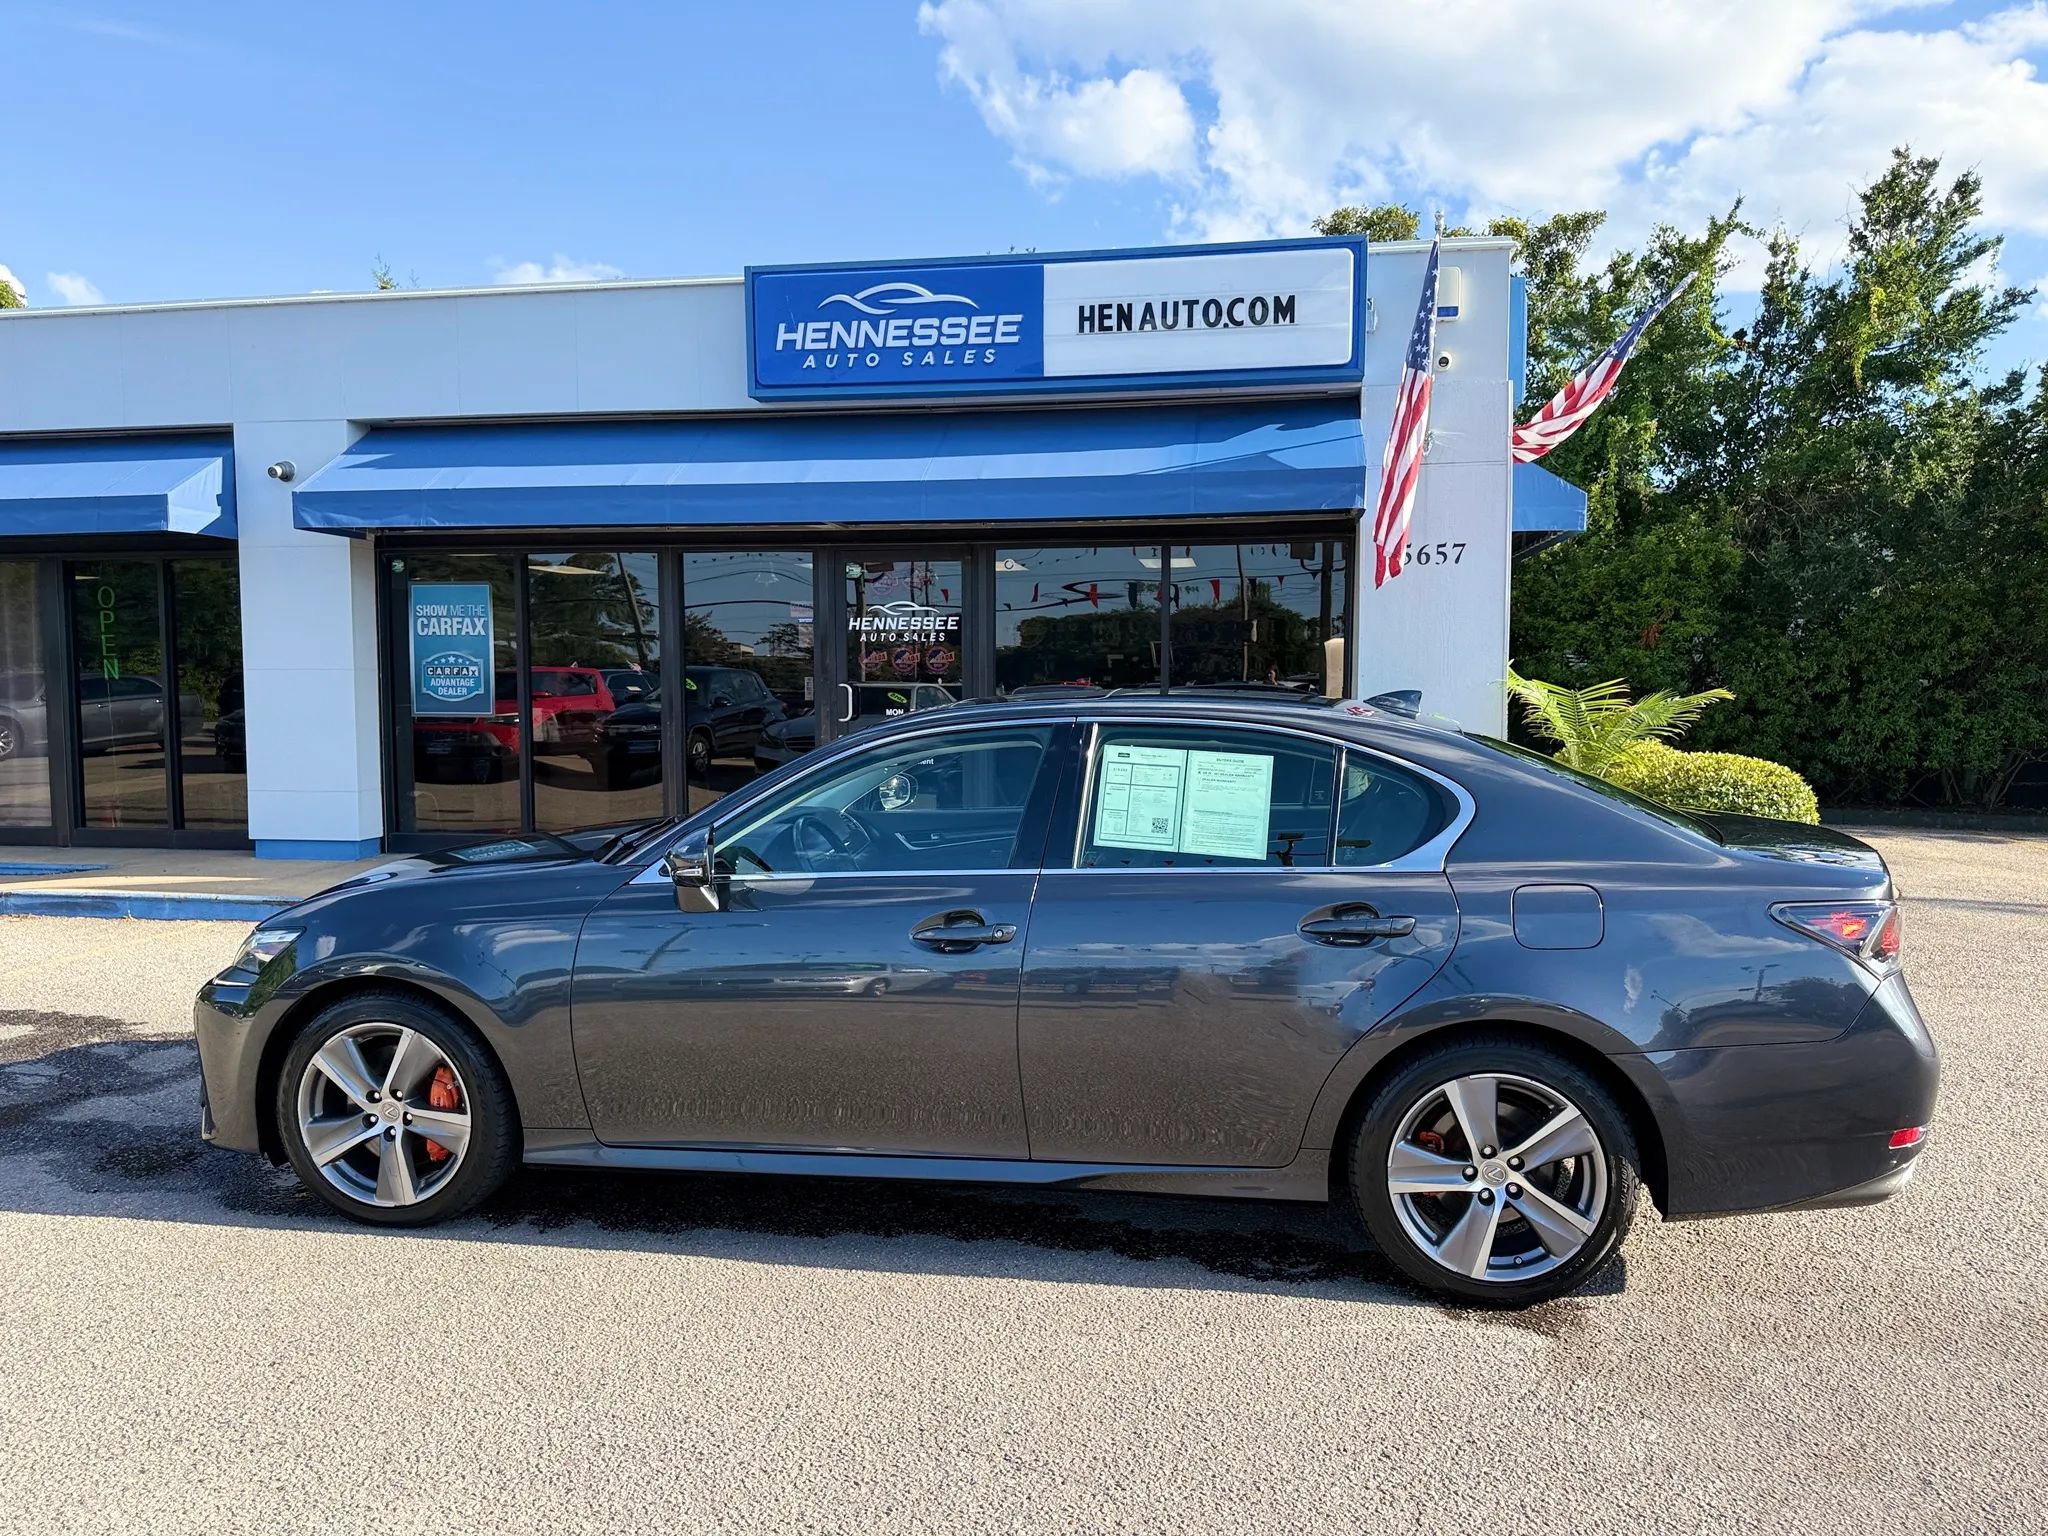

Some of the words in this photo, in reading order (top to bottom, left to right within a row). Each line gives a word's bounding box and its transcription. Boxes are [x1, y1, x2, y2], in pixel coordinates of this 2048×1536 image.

[1078, 295, 1296, 334] HENAUTO.COM
[776, 314, 1023, 351] HENNESSEE
[803, 352, 880, 369] AUTO
[902, 349, 996, 366] SALES
[416, 604, 448, 617] SHOW
[450, 604, 465, 617] ME
[467, 604, 486, 617] THE
[417, 617, 487, 636] CARFAX
[848, 616, 960, 631] HENNESSEE
[97, 586, 119, 681] OPEN
[860, 632, 897, 642] AUTO
[903, 632, 946, 642] SALES
[427, 666, 479, 676] CARFAX
[430, 678, 476, 687] ADVANTAGE
[438, 687, 468, 696] DEALER
[885, 708, 904, 716] MON
